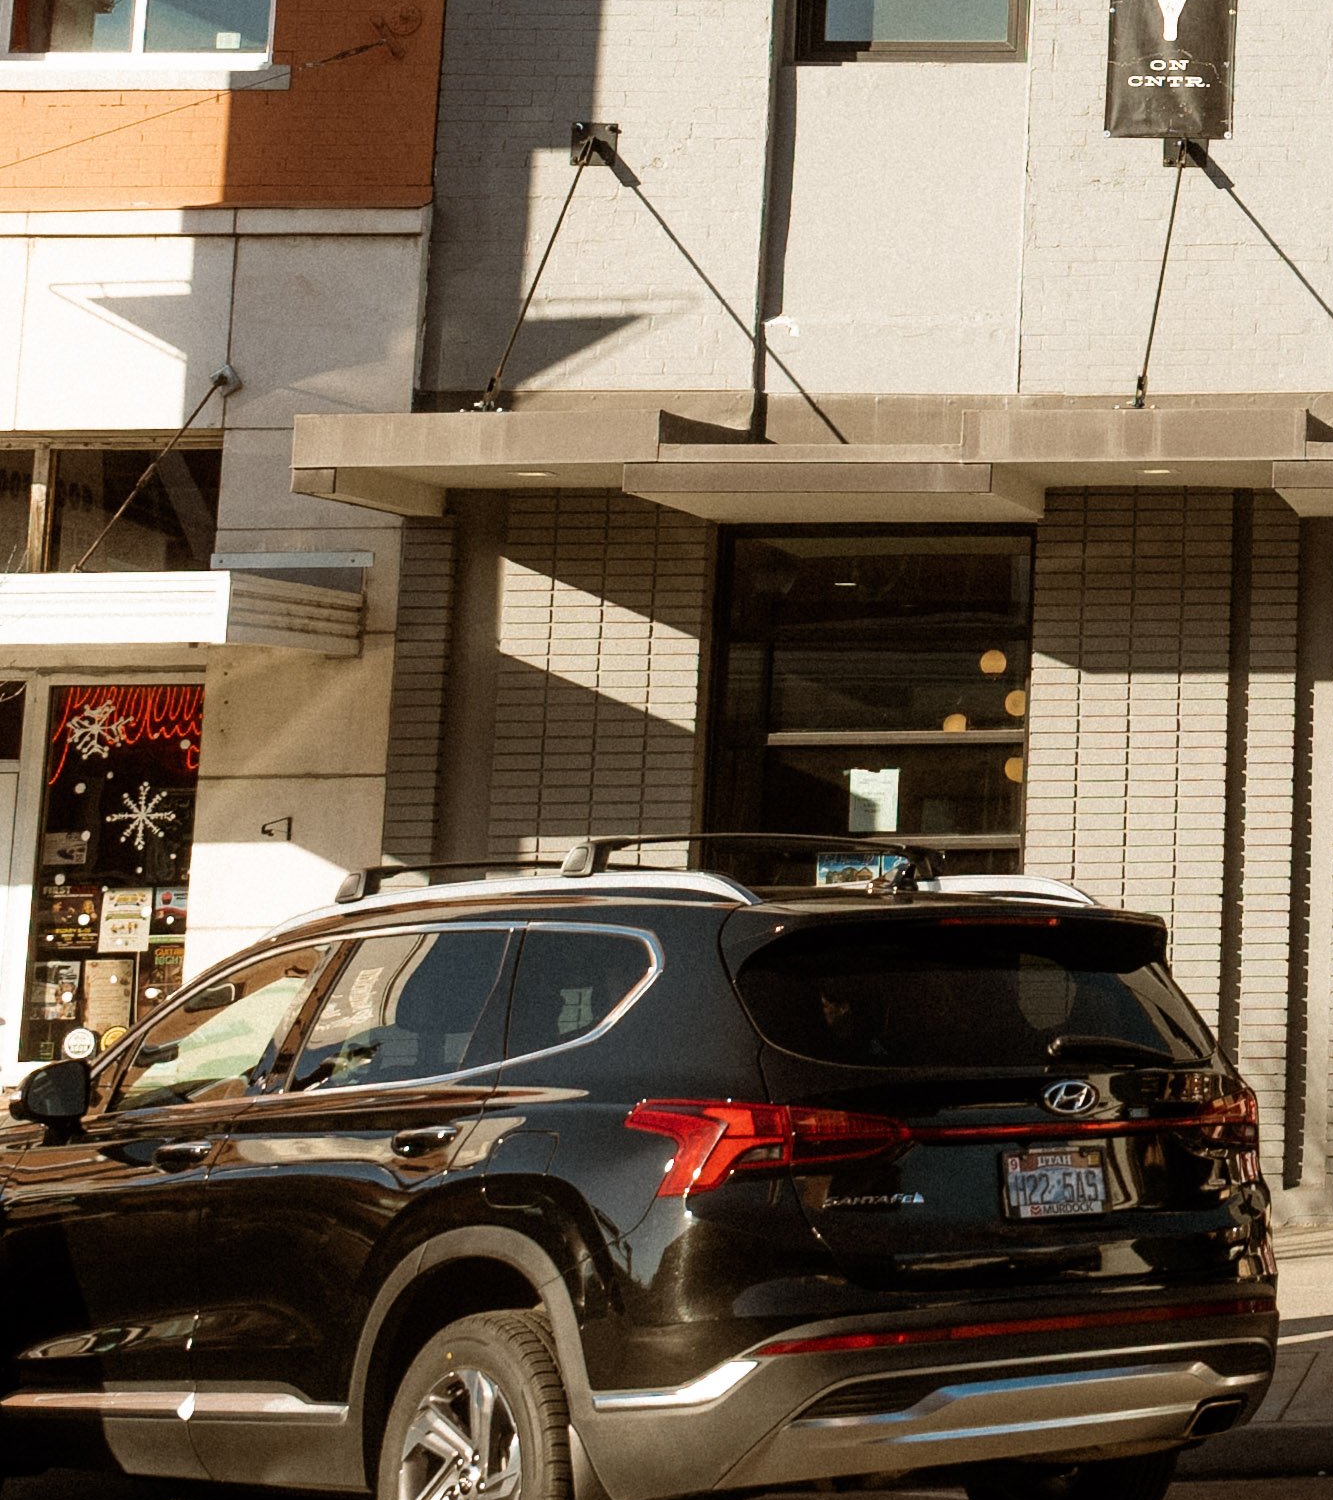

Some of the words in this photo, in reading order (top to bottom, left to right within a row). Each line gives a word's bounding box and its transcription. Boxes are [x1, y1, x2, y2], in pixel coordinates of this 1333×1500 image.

[1149, 58, 1190, 72] ON
[1127, 74, 1212, 89] CNTR.
[42, 885, 72, 895] FIRST
[1036, 1154, 1073, 1168] UTAH
[1043, 1202, 1094, 1214] MURDOCK
